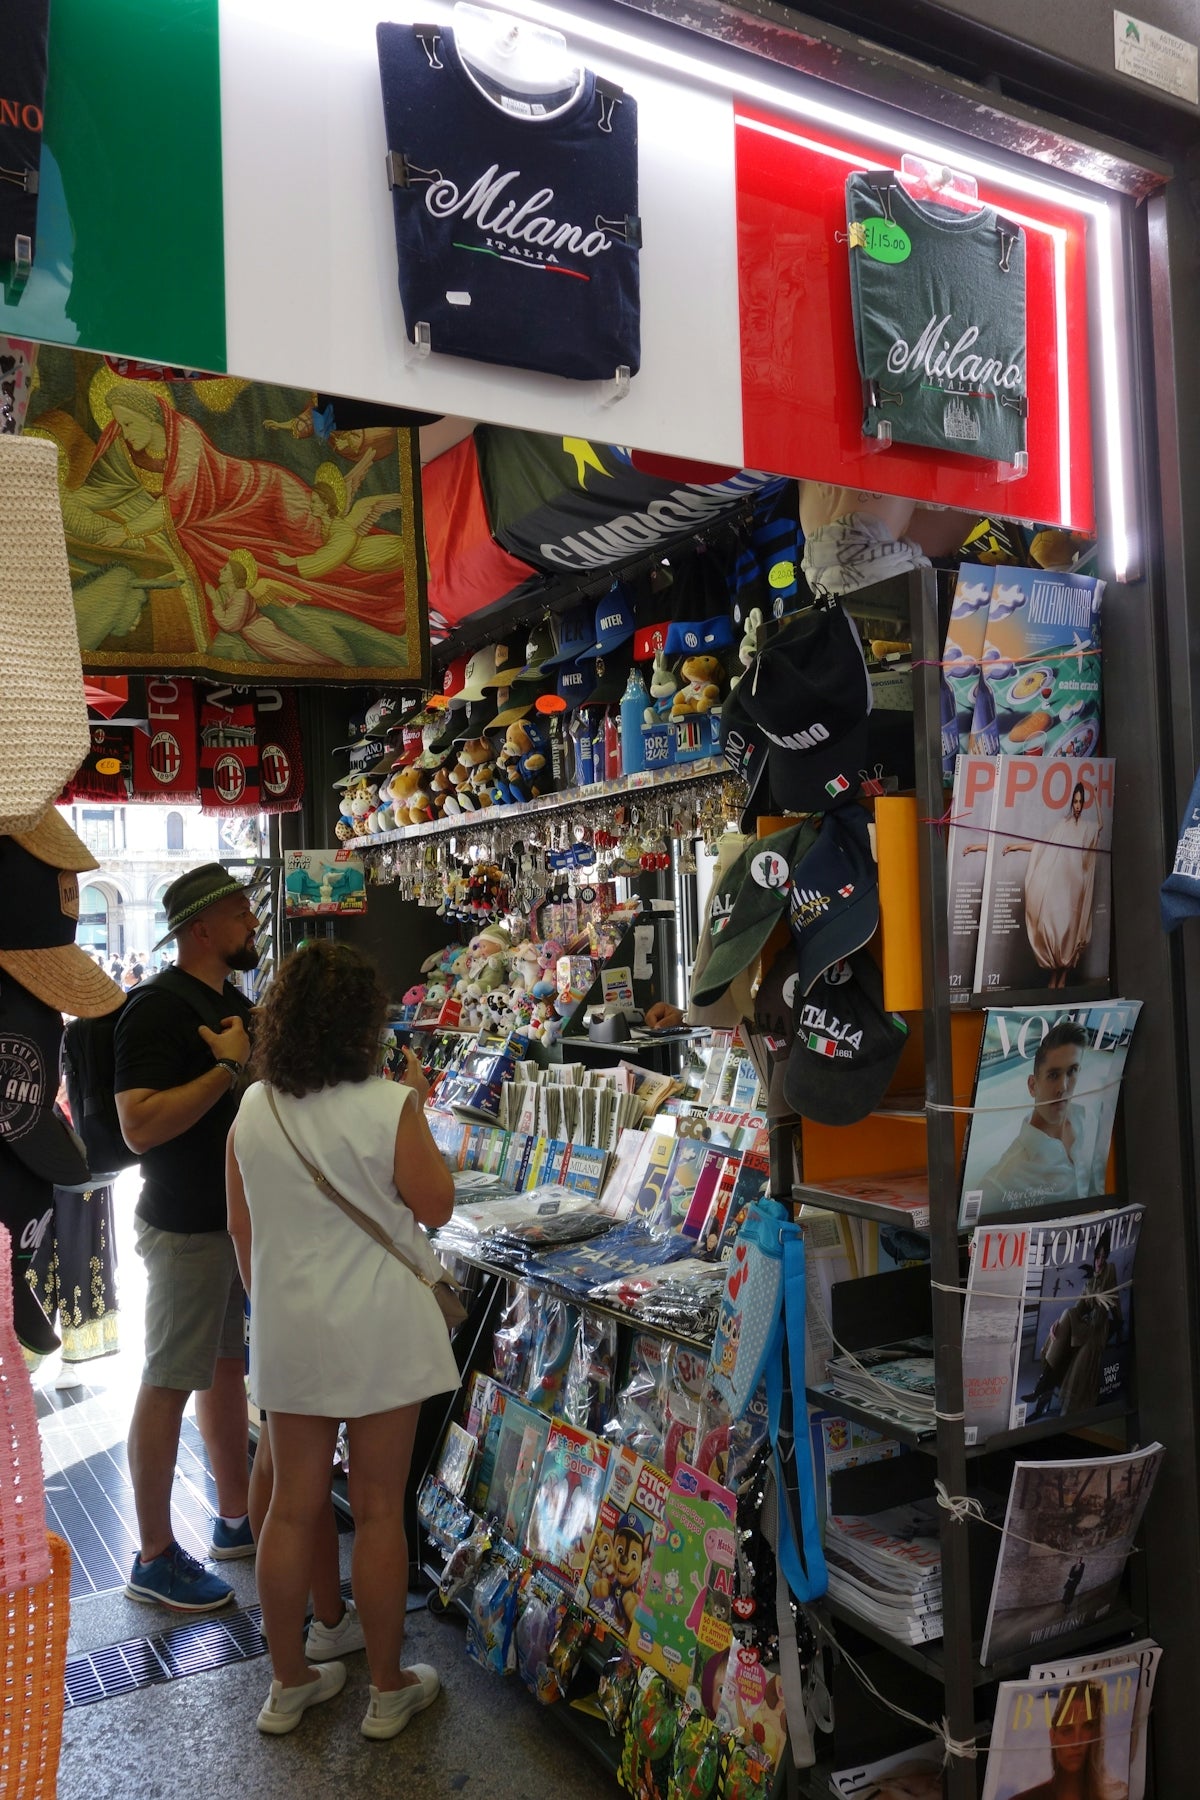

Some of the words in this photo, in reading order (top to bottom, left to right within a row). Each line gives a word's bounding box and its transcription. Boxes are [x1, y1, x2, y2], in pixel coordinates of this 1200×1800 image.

[426, 164, 612, 257] Milano
[485, 238, 559, 263] ITALIA
[887, 314, 1022, 390] Milano
[928, 377, 985, 393] ITALIA
[600, 613, 623, 631] INTER
[562, 673, 583, 687] INTER
[156, 733, 175, 742] ACM
[264, 748, 282, 758] ACM
[580, 737, 593, 760] INTER
[221, 757, 237, 767] ACM
[157, 770, 174, 780] 1899
[1004, 761, 1113, 810] POSH
[949, 974, 962, 987] 121
[988, 973, 1000, 985] 121
[800, 1004, 863, 1051] ITALIA
[995, 1008, 1127, 1060] VOE
[677, 1116, 707, 1139] GQ
[570, 1160, 600, 1176] MILANO
[964, 1376, 1008, 1388] ORLANDO
[968, 1386, 1002, 1397] BLOOM
[736, 1600, 753, 1616] ty
[740, 1651, 757, 1664] ty
[1011, 1675, 1132, 1731] BAZAAR
